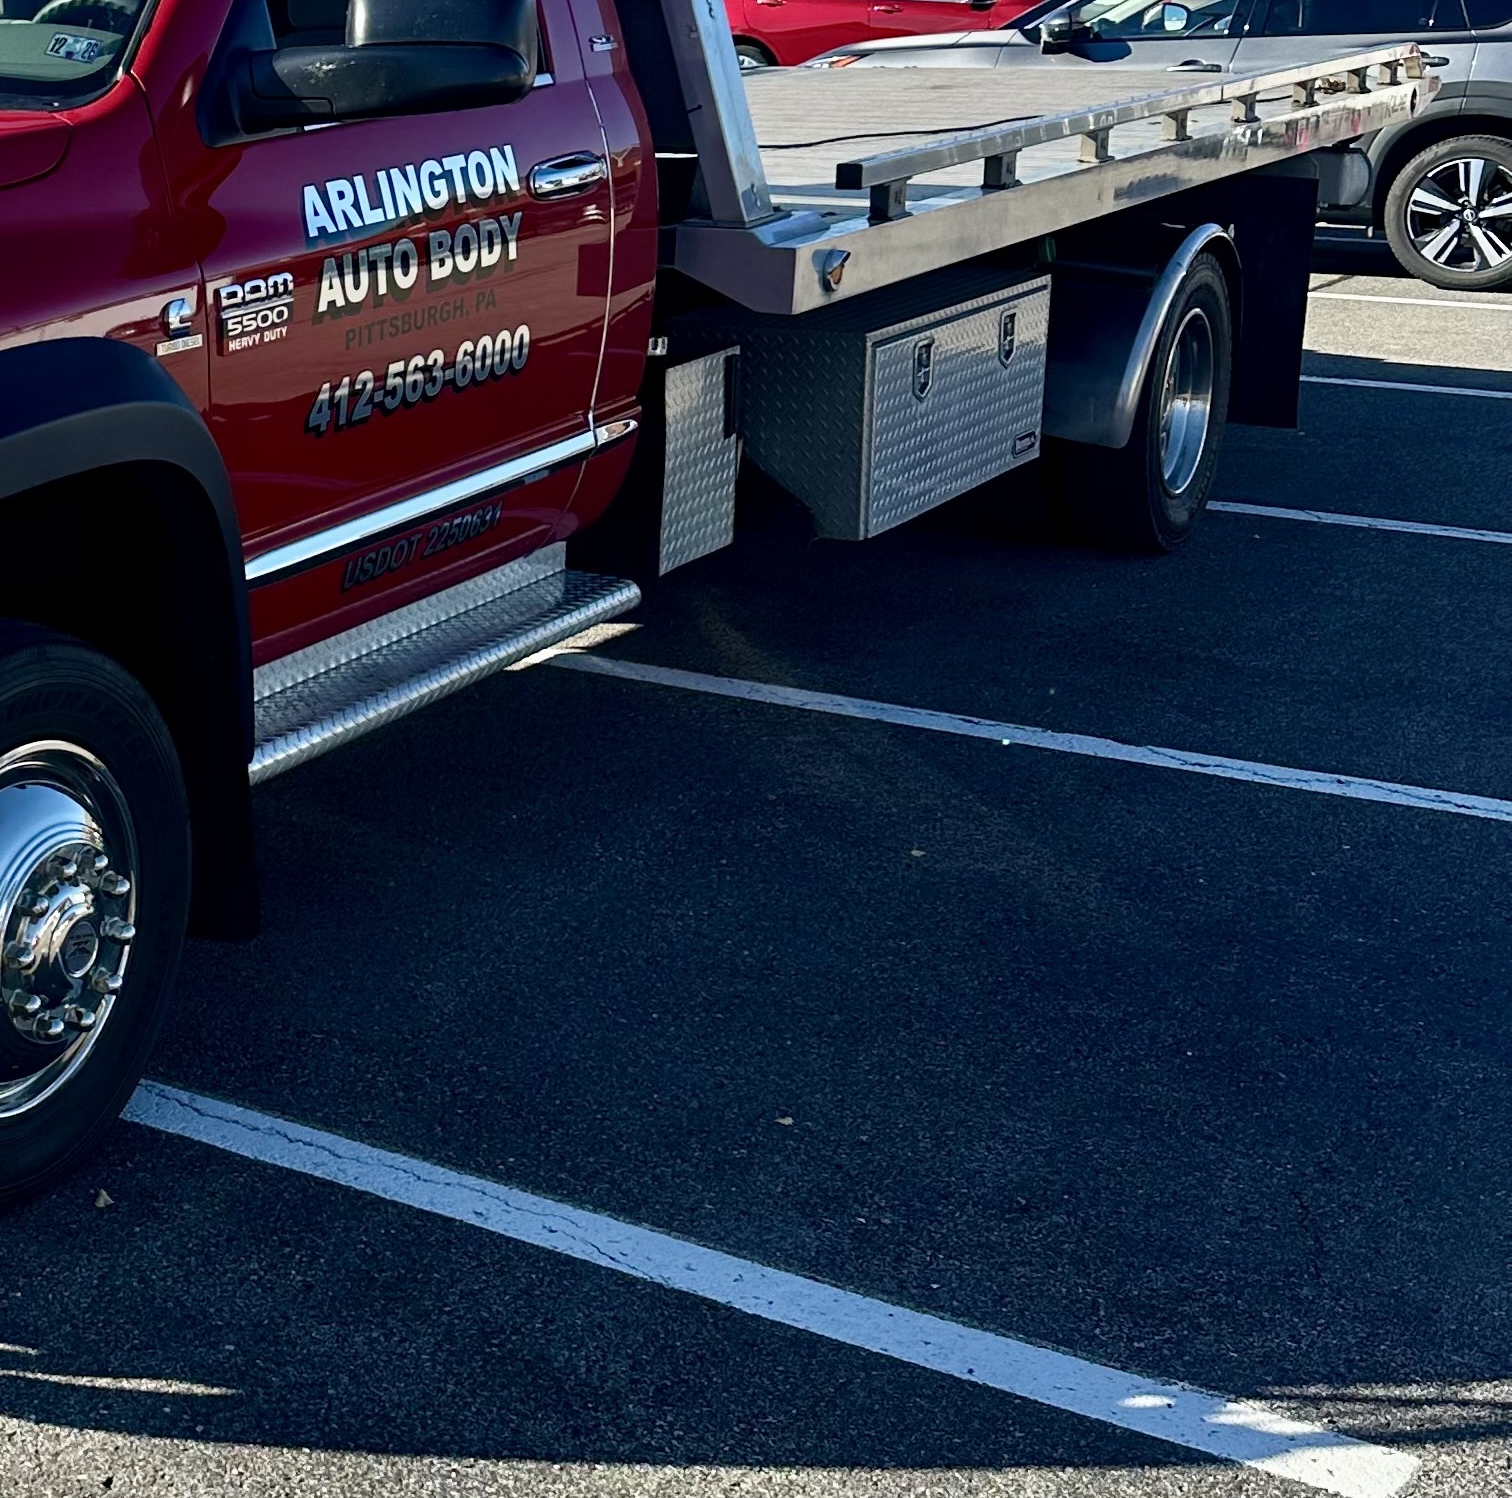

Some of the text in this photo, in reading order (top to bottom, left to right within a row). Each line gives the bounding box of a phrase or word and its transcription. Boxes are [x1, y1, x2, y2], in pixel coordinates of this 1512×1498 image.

[49, 36, 99, 60] 12 26
[302, 143, 522, 240] ARLINGTON
[316, 210, 524, 314] AUTO BODY
[227, 305, 289, 337] 5500
[228, 325, 288, 352] HEAVY DUTY
[344, 289, 498, 351] PITTSBURGH, PA
[306, 322, 532, 434] 412-563-6000
[343, 499, 503, 590] USDOT 2250631
